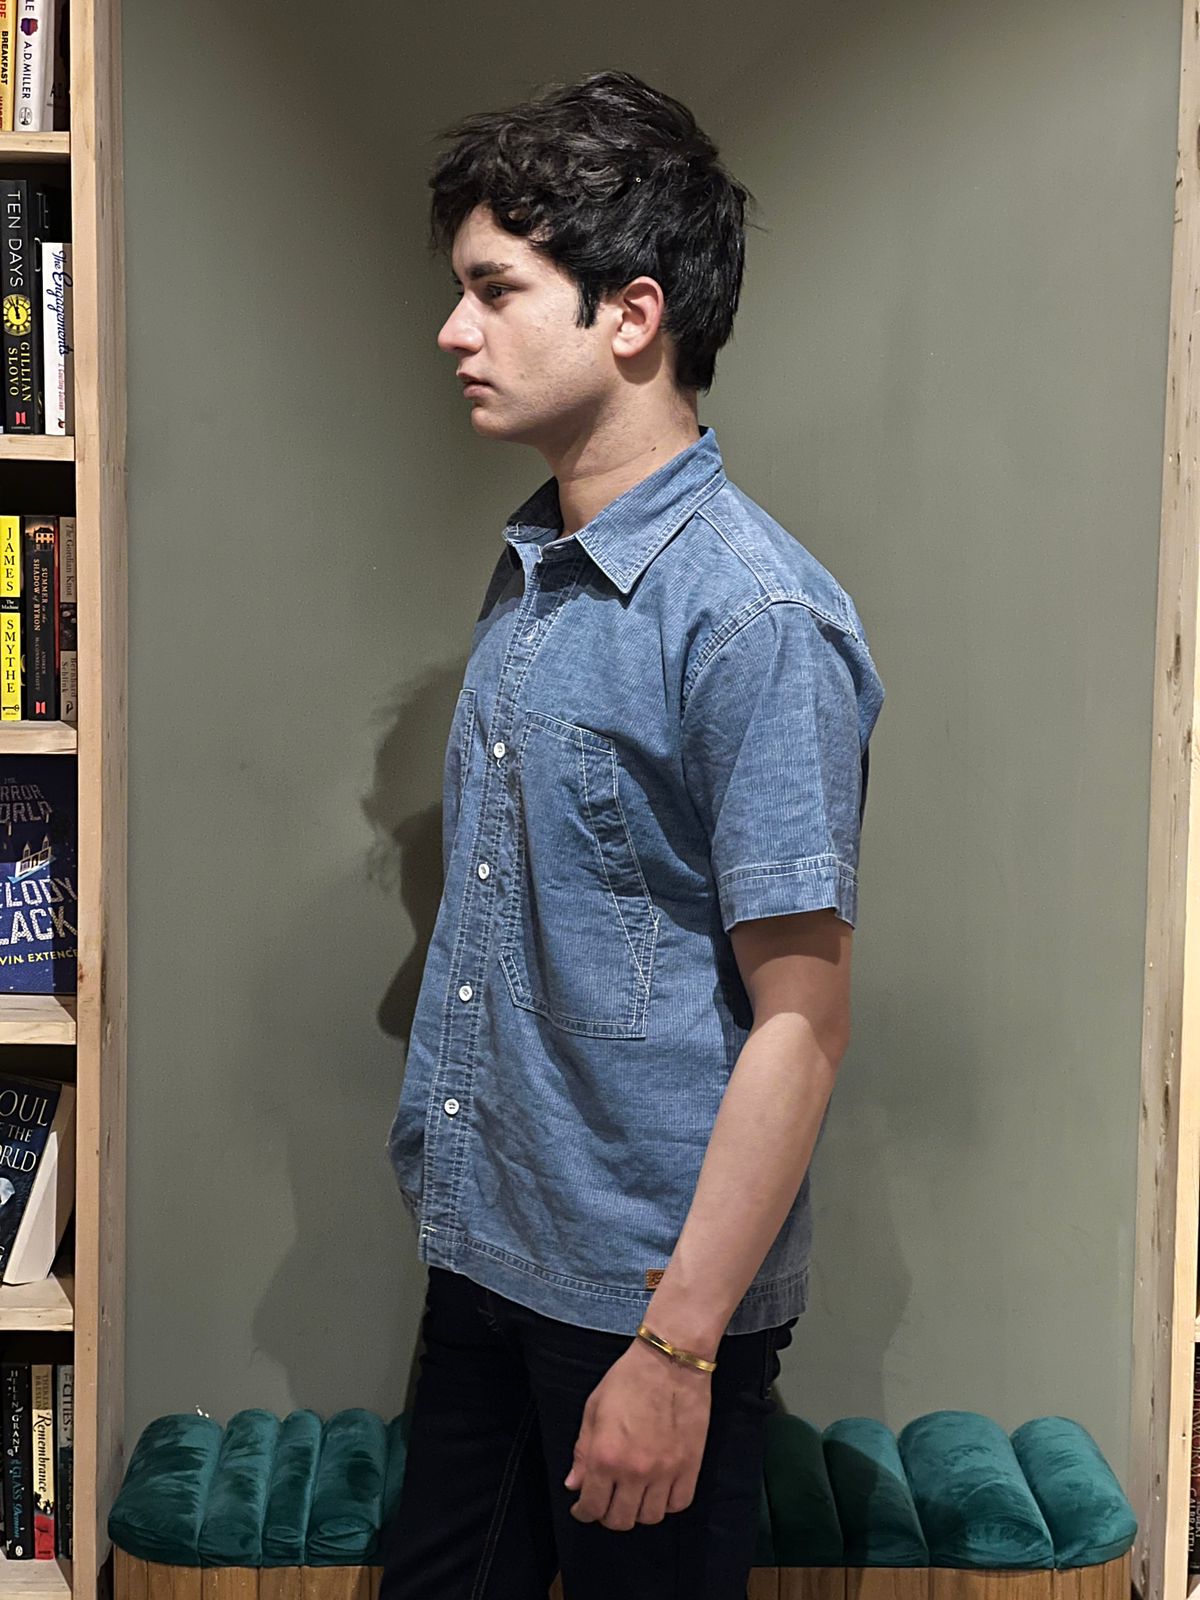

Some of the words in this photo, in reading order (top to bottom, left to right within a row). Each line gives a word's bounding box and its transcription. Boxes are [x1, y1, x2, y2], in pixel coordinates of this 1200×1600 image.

[1, 30, 9, 85] BREAKFAST
[8, 190, 21, 229] TEN
[9, 238, 24, 287] DAYS
[52, 251, 67, 270] The
[46, 272, 74, 356] Engagements
[8, 347, 19, 396] SLOVO
[20, 342, 32, 402] GILLIAN
[4, 527, 15, 592] JAMES
[66, 575, 75, 596] Knot
[33, 604, 41, 631] BYRON
[4, 619, 16, 693] SMYTHE
[0, 784, 44, 800] RROR
[0, 877, 78, 907] LODY
[0, 955, 24, 966] VIN
[0, 1090, 48, 1126] OUL
[8, 1124, 33, 1142] THE
[12, 1414, 20, 1453] GRANT
[33, 1414, 52, 1493] Remembrance
